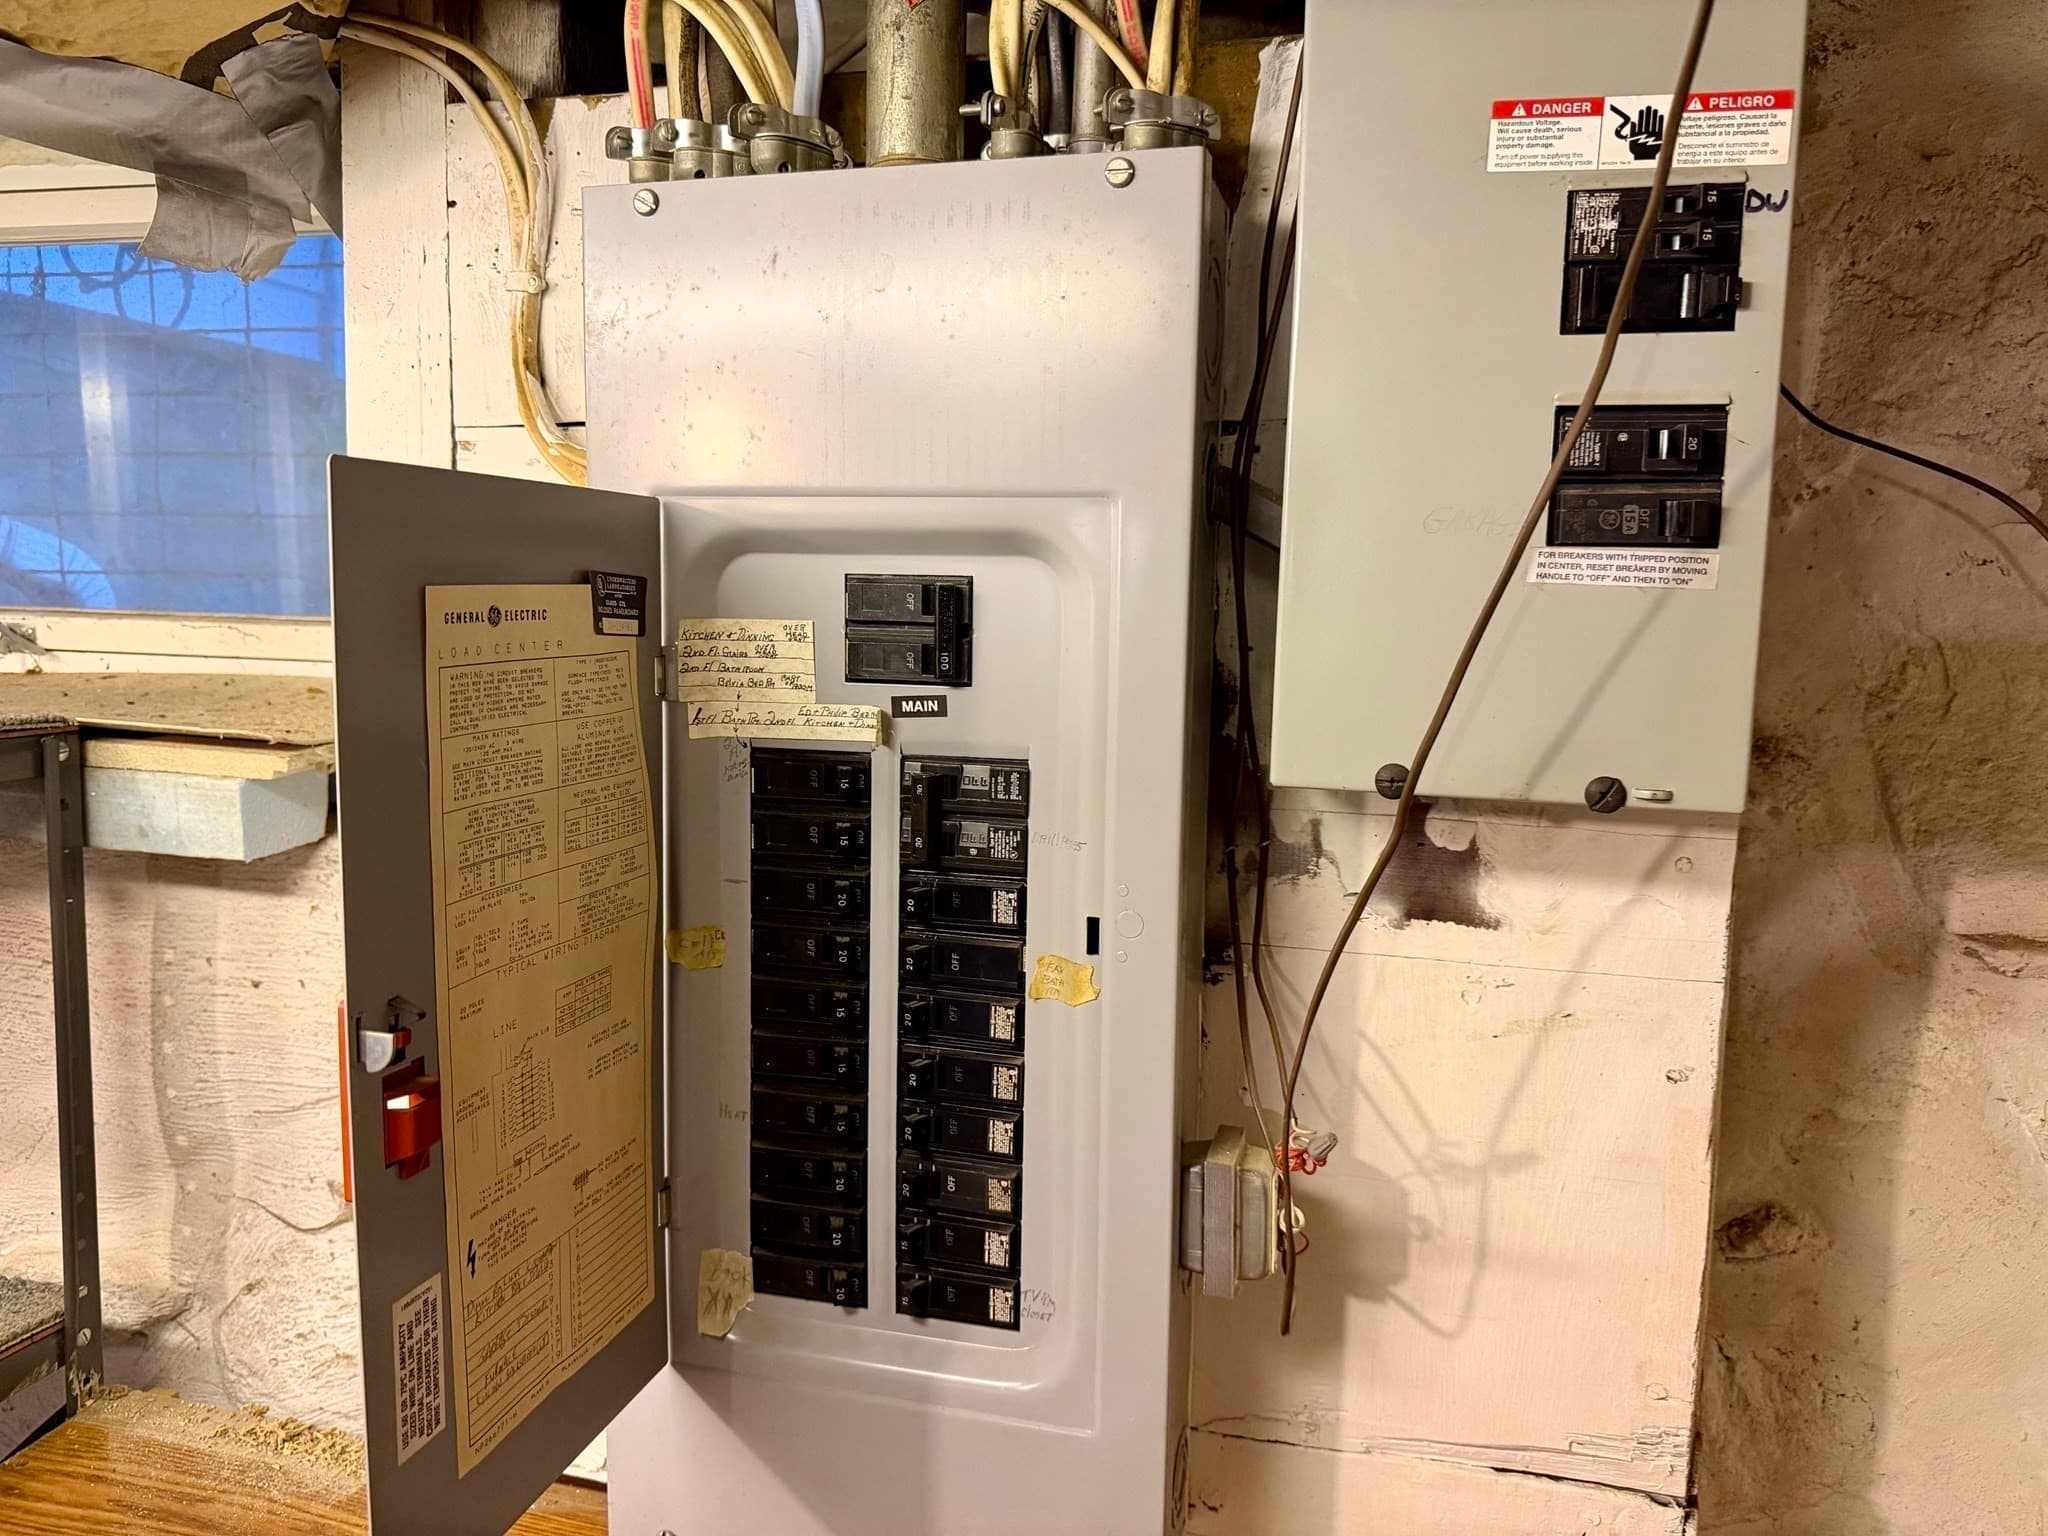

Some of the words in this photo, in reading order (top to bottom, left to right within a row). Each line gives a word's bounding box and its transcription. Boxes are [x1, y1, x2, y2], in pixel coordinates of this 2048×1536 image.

[1532, 102, 1591, 114] DANGER
[1709, 96, 1775, 108] PELIGRO
[1526, 133, 1564, 141] substantial
[1707, 190, 1717, 203] 15
[1744, 188, 1788, 214] DW
[1702, 229, 1712, 241] 15
[1688, 437, 1698, 450] 20
[1624, 507, 1636, 532] 15A
[1558, 552, 1603, 561] BREAKERS
[1630, 554, 1666, 562] TRIPPED
[1668, 556, 1709, 564] POSITION
[1548, 563, 1584, 571] CENTER,
[1616, 565, 1656, 573] BREAKER
[1672, 567, 1708, 575] MOVING
[1536, 573, 1570, 581] HANDLE
[906, 592, 914, 611] OFF
[444, 611, 485, 624] GENERAL
[505, 609, 548, 621] ELECTRIC
[439, 645, 482, 660] LOAD
[495, 640, 563, 654] CENTER
[906, 652, 914, 670] OFF
[940, 653, 949, 670] 100
[902, 700, 938, 712] MAIN
[840, 779, 849, 789] 15
[840, 836, 849, 846] 15
[915, 837, 923, 848] 30
[838, 894, 847, 906] 20
[907, 899, 915, 912] 20
[544, 942, 579, 960] WIRING
[838, 950, 847, 963] 20
[906, 957, 914, 970] 20
[951, 953, 960, 971] OFF
[836, 1007, 845, 1018] 15
[905, 1013, 912, 1026] 20
[493, 1019, 518, 1038] LINE
[838, 1063, 846, 1073] 15
[909, 1073, 917, 1086] 20
[837, 1121, 846, 1131] 15
[905, 1127, 912, 1140] 20
[835, 1178, 844, 1191] 20
[902, 1184, 910, 1196] 20
[947, 1176, 956, 1192] OFF
[832, 1233, 842, 1246] 20
[836, 1288, 845, 1300] 20
[422, 1297, 430, 1325] THEIR
[414, 1309, 422, 1328] SEE
[423, 1327, 431, 1346] FOR
[398, 1323, 407, 1370] AMPACITY
[407, 1343, 415, 1364] LINE
[424, 1348, 433, 1397] BREAKERS
[431, 1334, 441, 1401] TEMPERATURE
[408, 1367, 416, 1382] ON
[400, 1398, 408, 1412] OR
[417, 1393, 425, 1438] NEUTRAL
[425, 1398, 434, 1435] CIRCUIT
[433, 1402, 441, 1429] WIRE
[401, 1428, 409, 1449] USE
